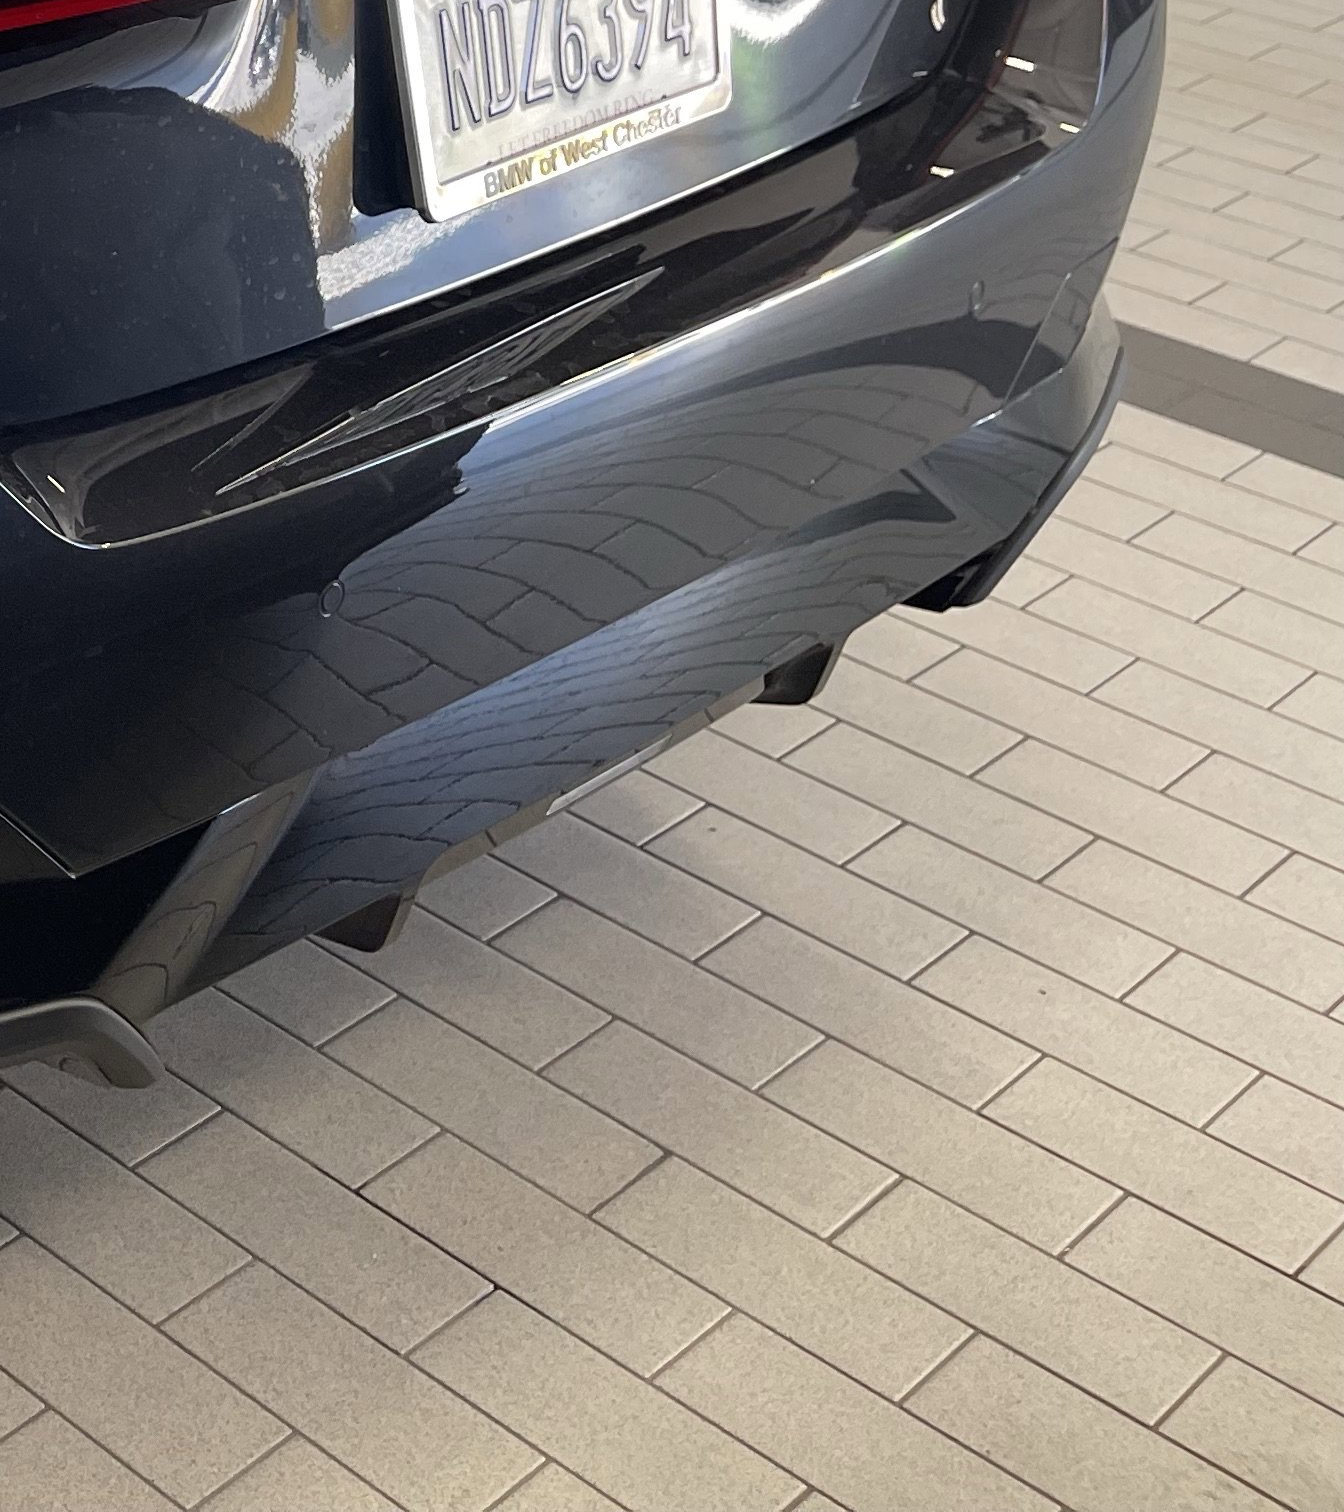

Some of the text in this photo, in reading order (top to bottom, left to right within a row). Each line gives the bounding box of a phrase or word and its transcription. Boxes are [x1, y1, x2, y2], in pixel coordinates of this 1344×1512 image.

[483, 103, 682, 199] BMW of West Chester
